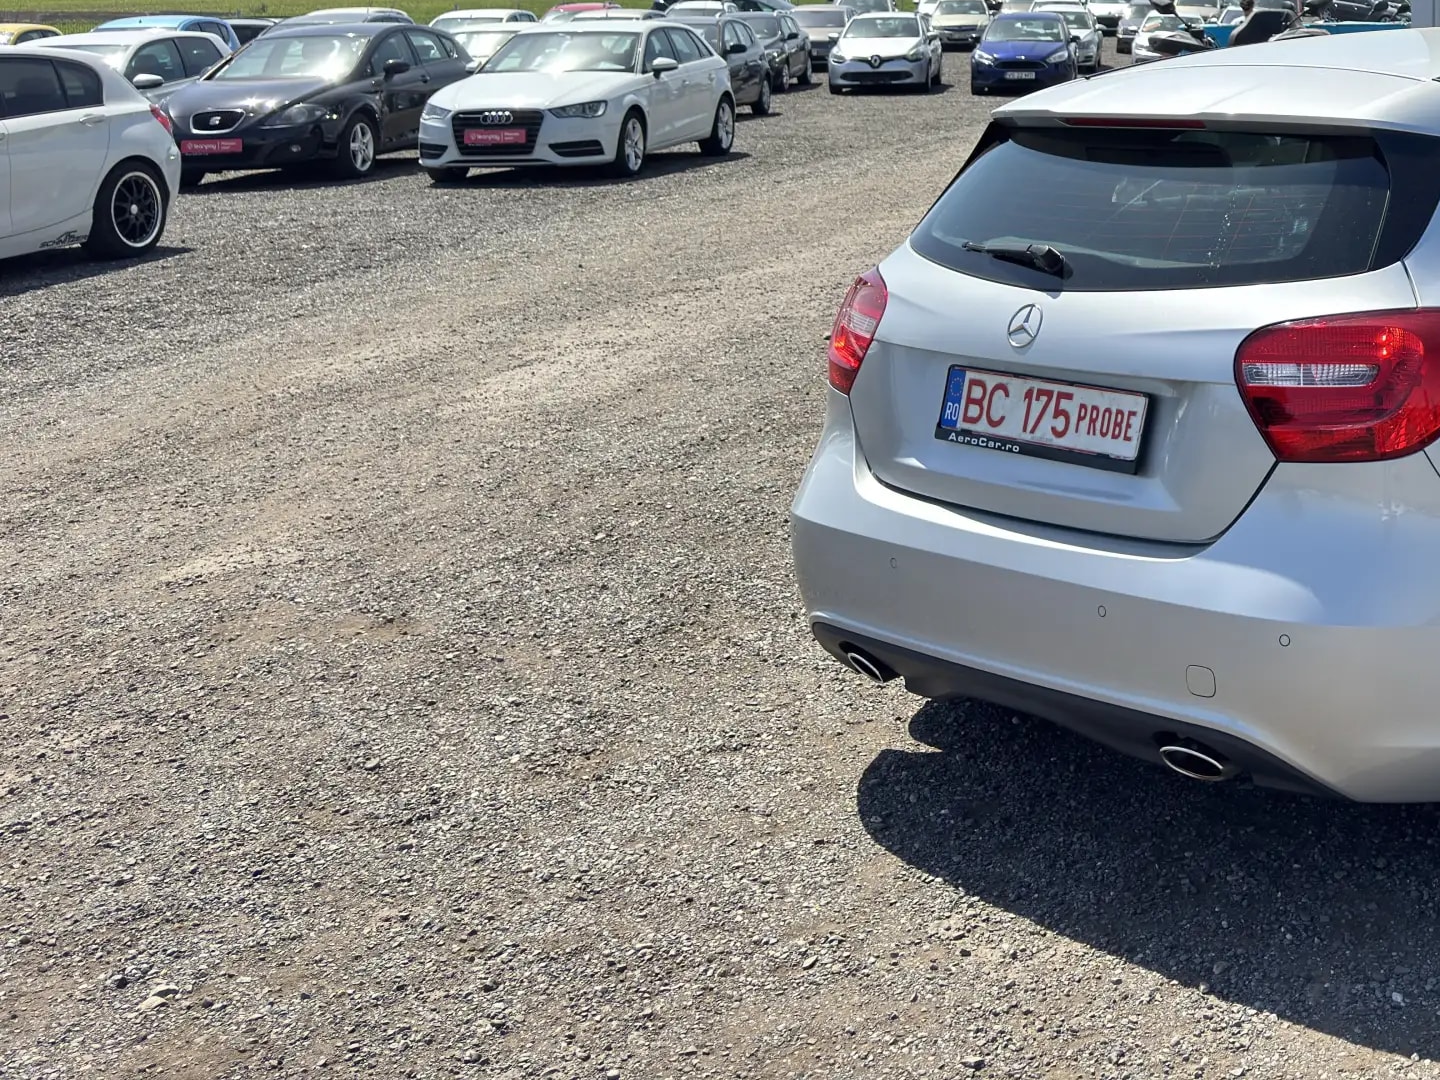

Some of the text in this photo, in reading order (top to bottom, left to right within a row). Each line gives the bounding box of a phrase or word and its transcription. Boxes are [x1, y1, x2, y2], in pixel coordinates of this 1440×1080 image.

[944, 378, 1138, 442] RO BC 175 PROBE
[948, 432, 1020, 453] AeroCar.ro
